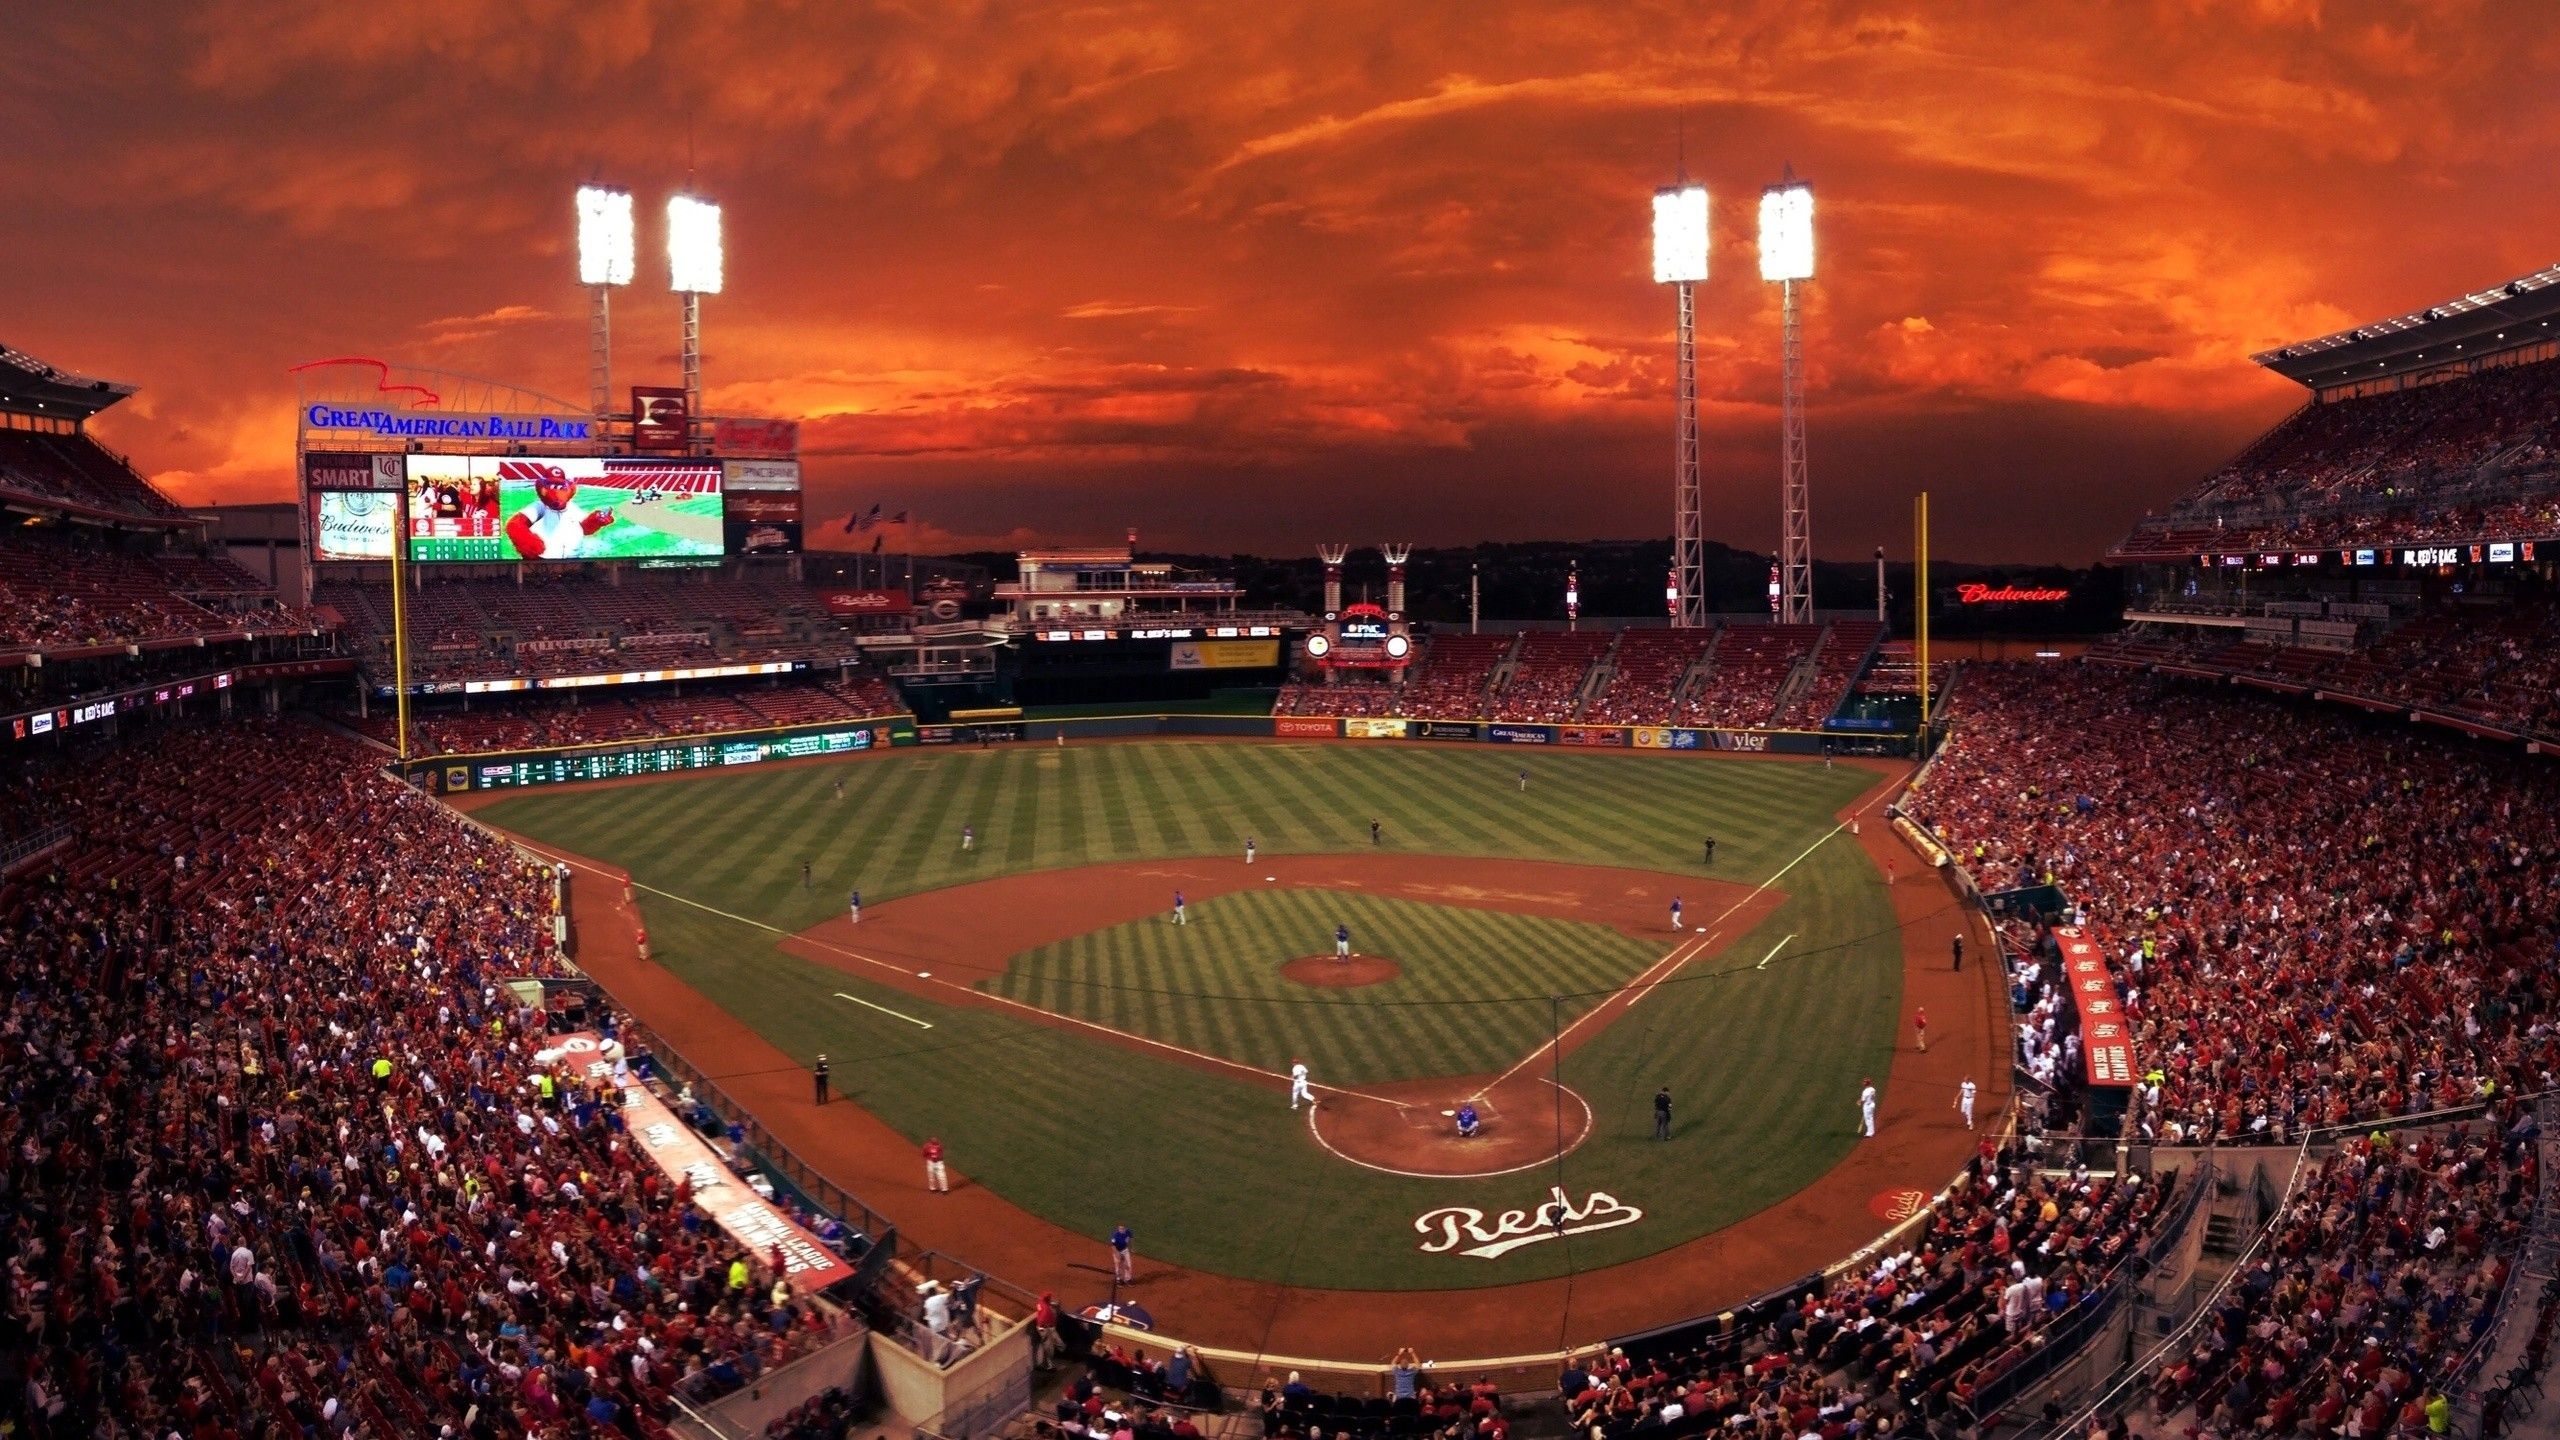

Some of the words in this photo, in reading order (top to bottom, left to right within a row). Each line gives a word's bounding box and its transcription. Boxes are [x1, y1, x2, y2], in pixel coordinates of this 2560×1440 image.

[309, 405, 384, 428] GREAT
[377, 414, 485, 437] AMERICAN
[488, 416, 537, 437] BALL
[539, 418, 591, 439] PARK
[312, 469, 370, 487] SMART
[2404, 550, 2417, 566] MR.
[2417, 547, 2438, 565] RED'S
[2438, 548, 2458, 564] RACE
[1957, 584, 2068, 602] Budweiser
[1357, 624, 1381, 633] PNC
[1295, 723, 1333, 732] TOYOTA
[771, 743, 790, 754] PNC
[1885, 1191, 1923, 1221] Reds
[1415, 1187, 1643, 1258] Reds
[785, 1237, 835, 1271] LEAGUE
